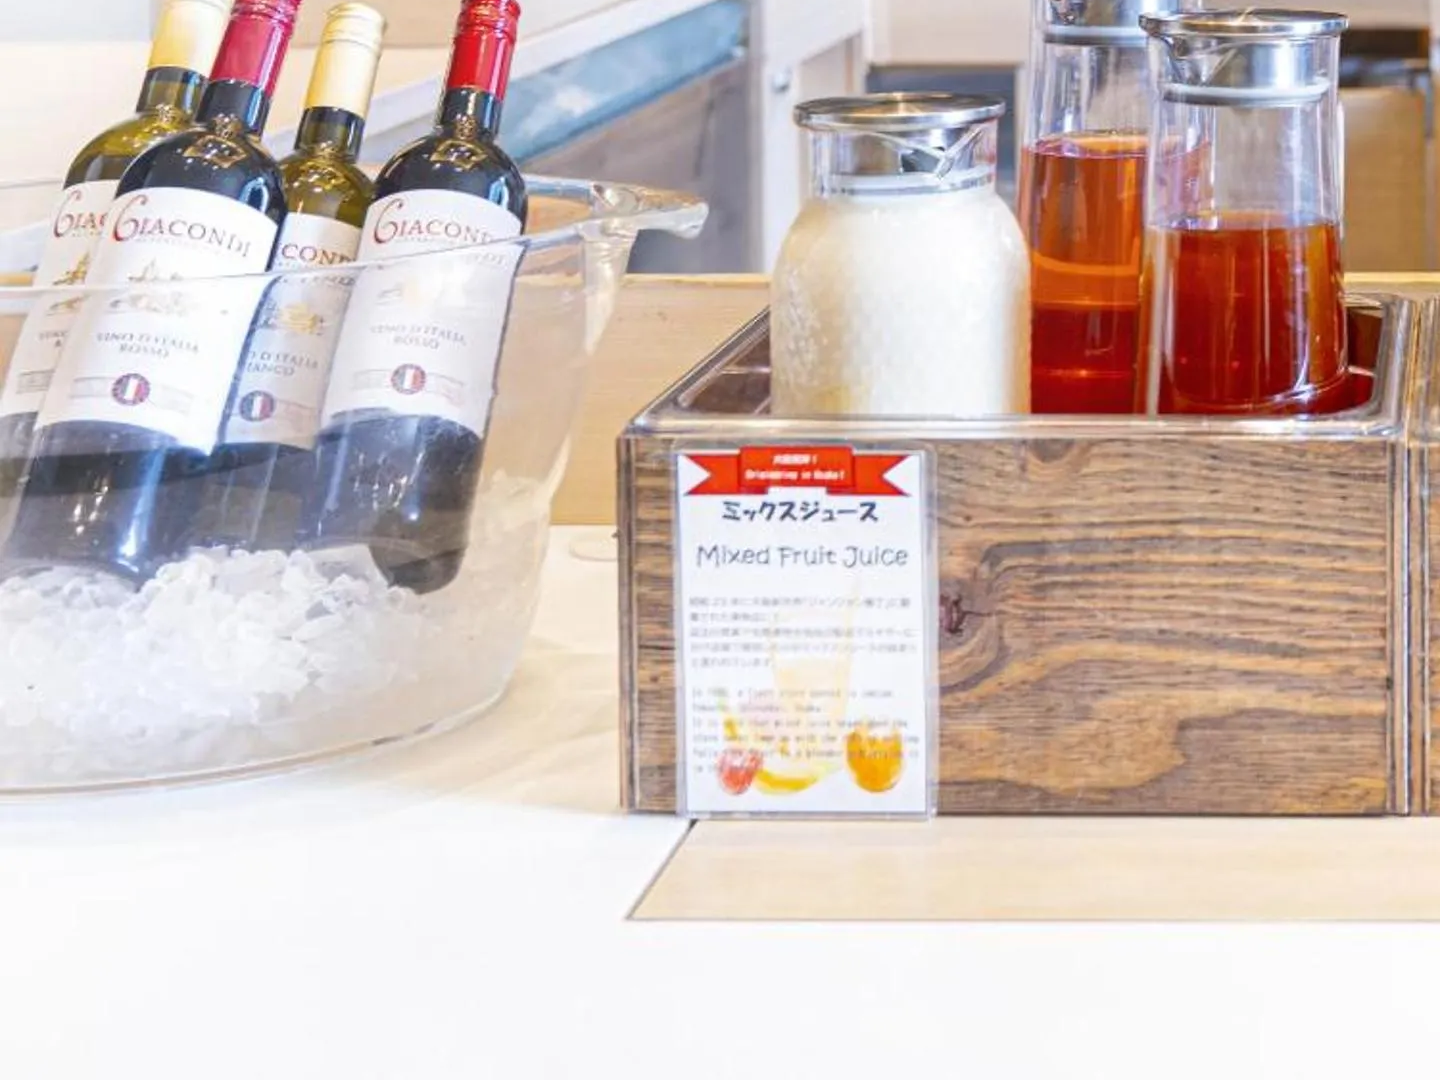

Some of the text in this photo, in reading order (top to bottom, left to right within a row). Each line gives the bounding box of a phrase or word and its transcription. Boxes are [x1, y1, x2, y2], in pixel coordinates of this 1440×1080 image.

[112, 194, 251, 257] GIACONDI
[722, 501, 878, 522] ミックスジュース
[697, 544, 908, 568] Mixed Fruit Juice
